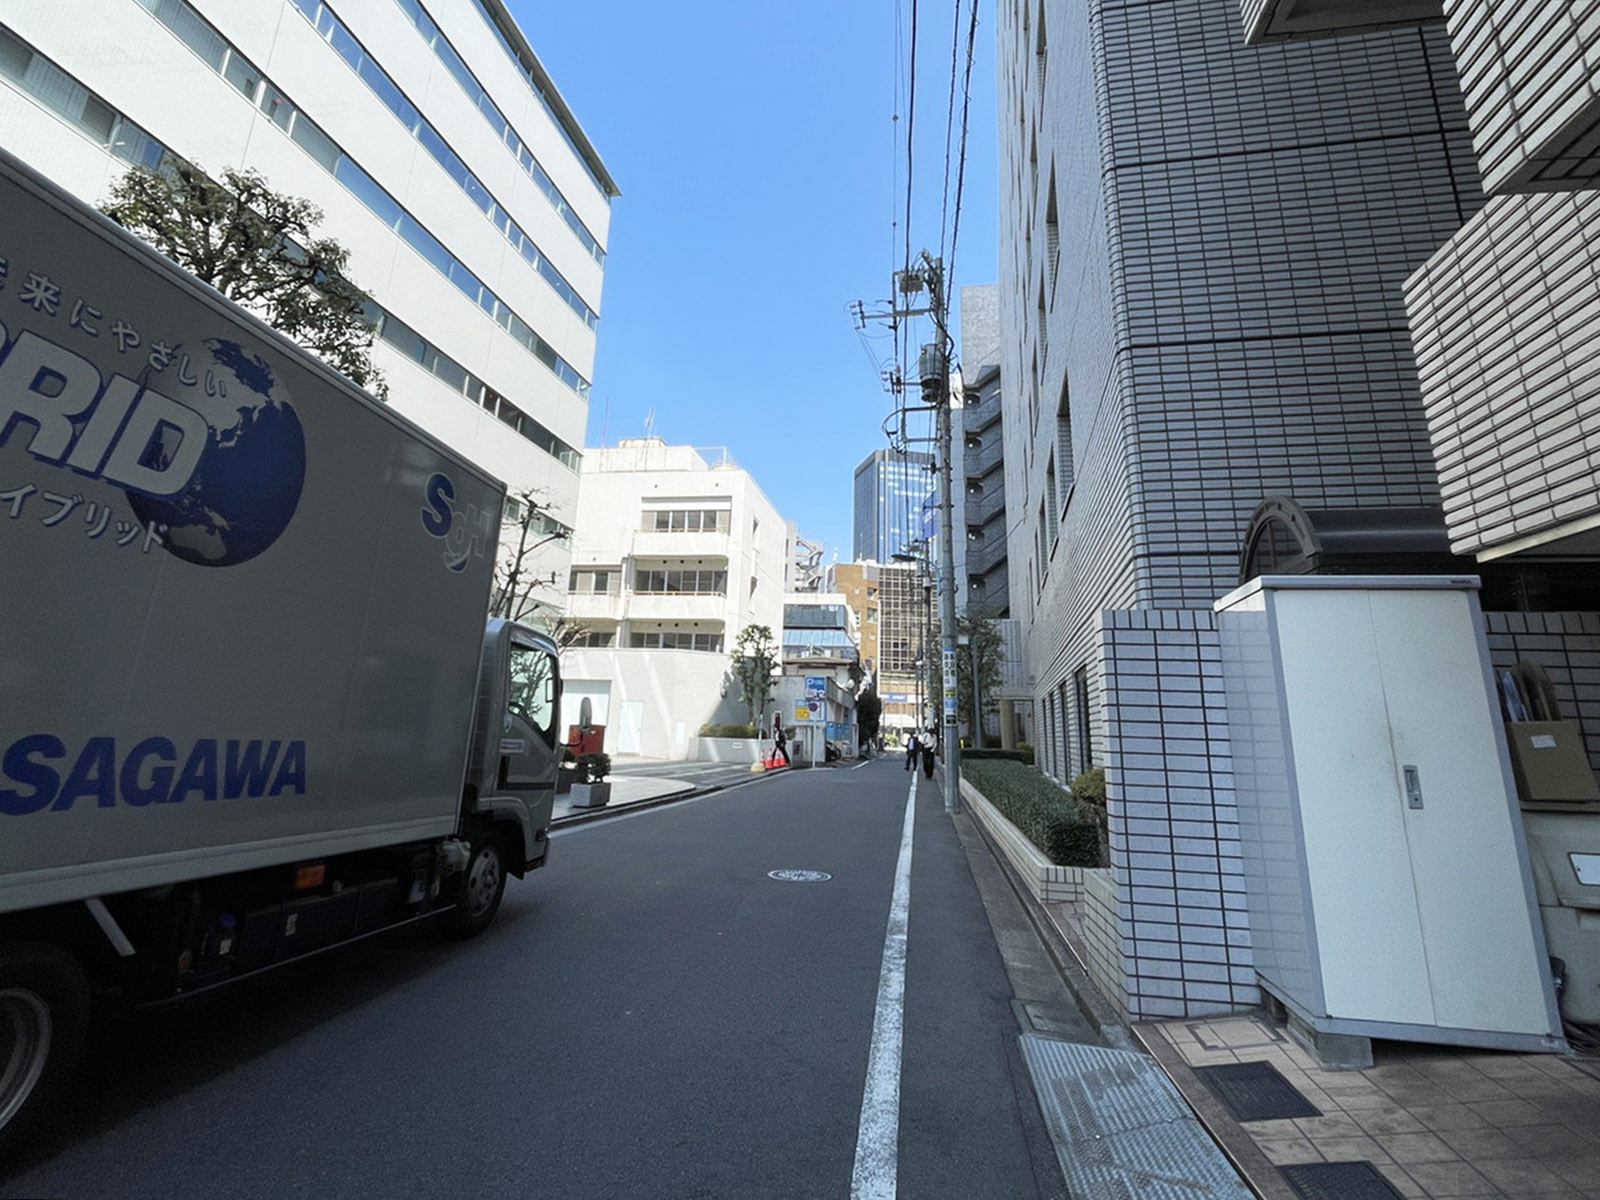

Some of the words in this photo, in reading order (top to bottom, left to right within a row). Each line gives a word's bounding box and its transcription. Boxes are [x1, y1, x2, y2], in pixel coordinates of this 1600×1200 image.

[0, 318, 209, 498] RID
[0, 484, 168, 552] イブリッド
[0, 734, 306, 816] SAGAWA
